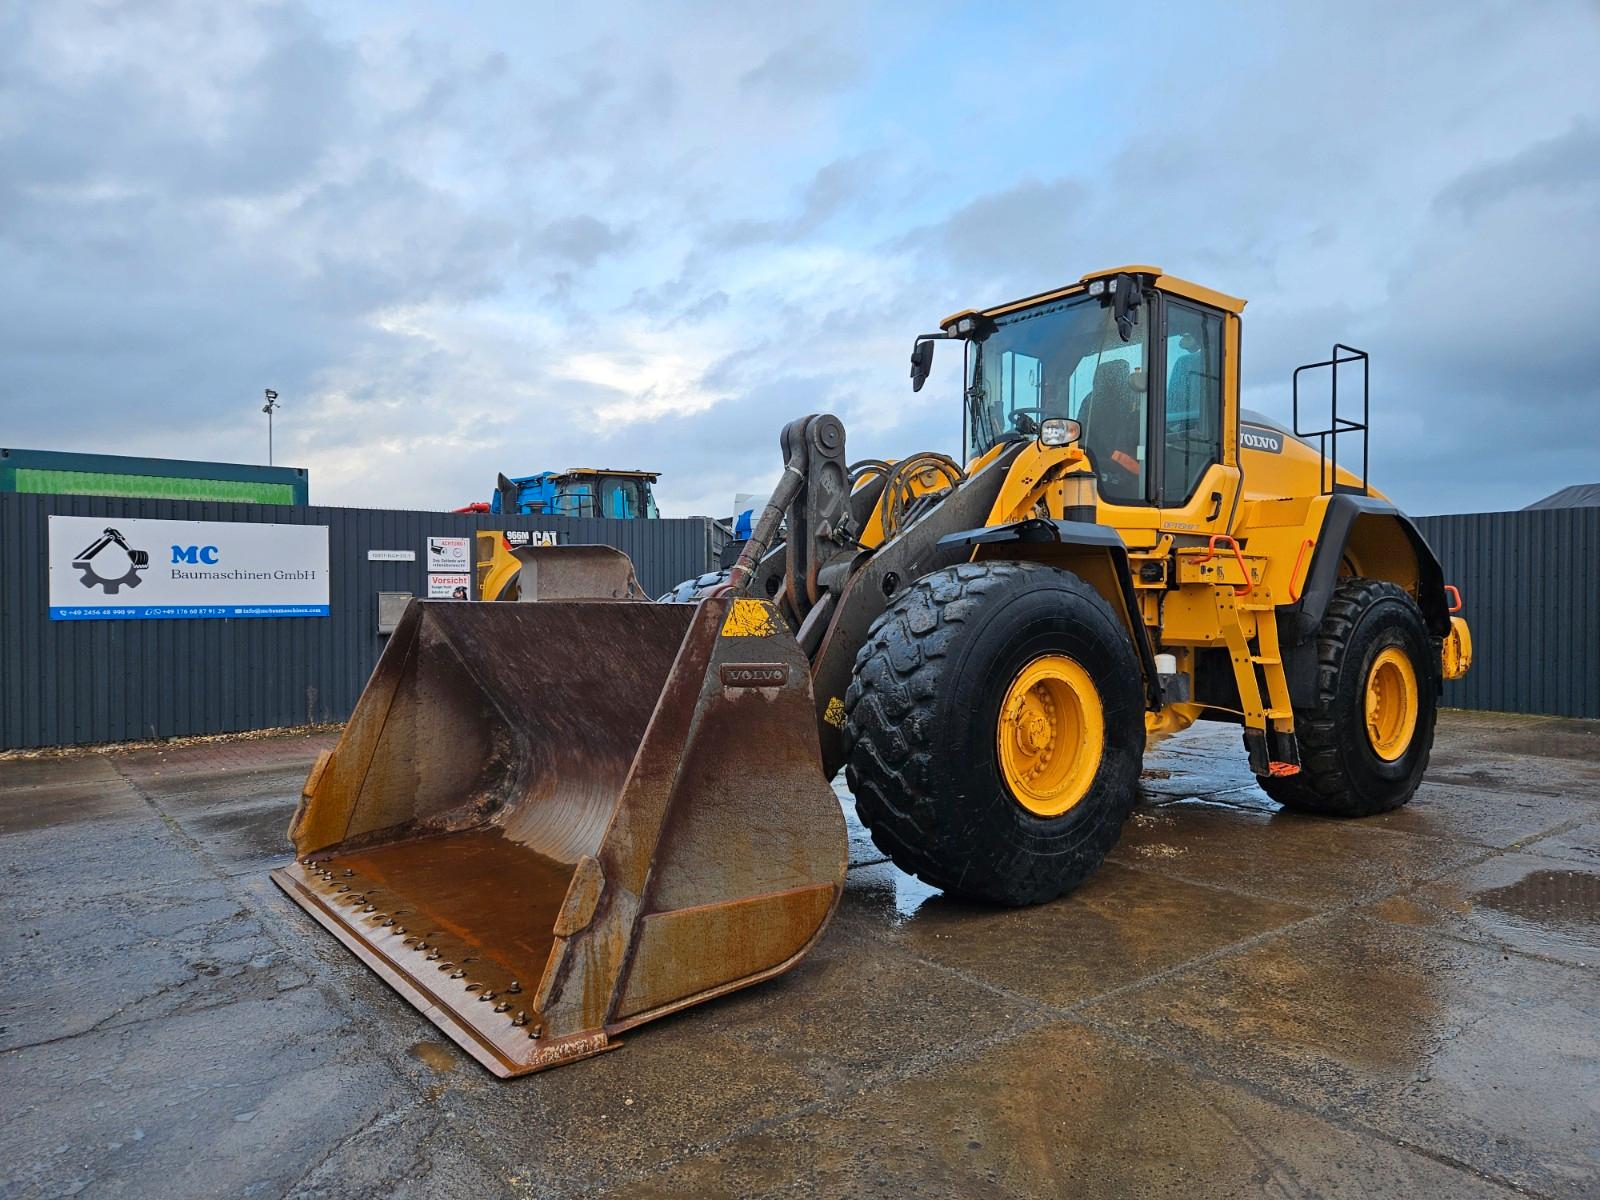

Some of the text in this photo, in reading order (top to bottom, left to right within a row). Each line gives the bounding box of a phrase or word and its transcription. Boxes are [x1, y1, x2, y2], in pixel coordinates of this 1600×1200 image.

[506, 531, 530, 540] 966M
[532, 531, 557, 546] CAT
[171, 545, 219, 564] MC
[171, 569, 316, 580] Baumaschinen GmbH
[432, 576, 467, 584] Vorsicht
[728, 670, 783, 680] VOLVO
